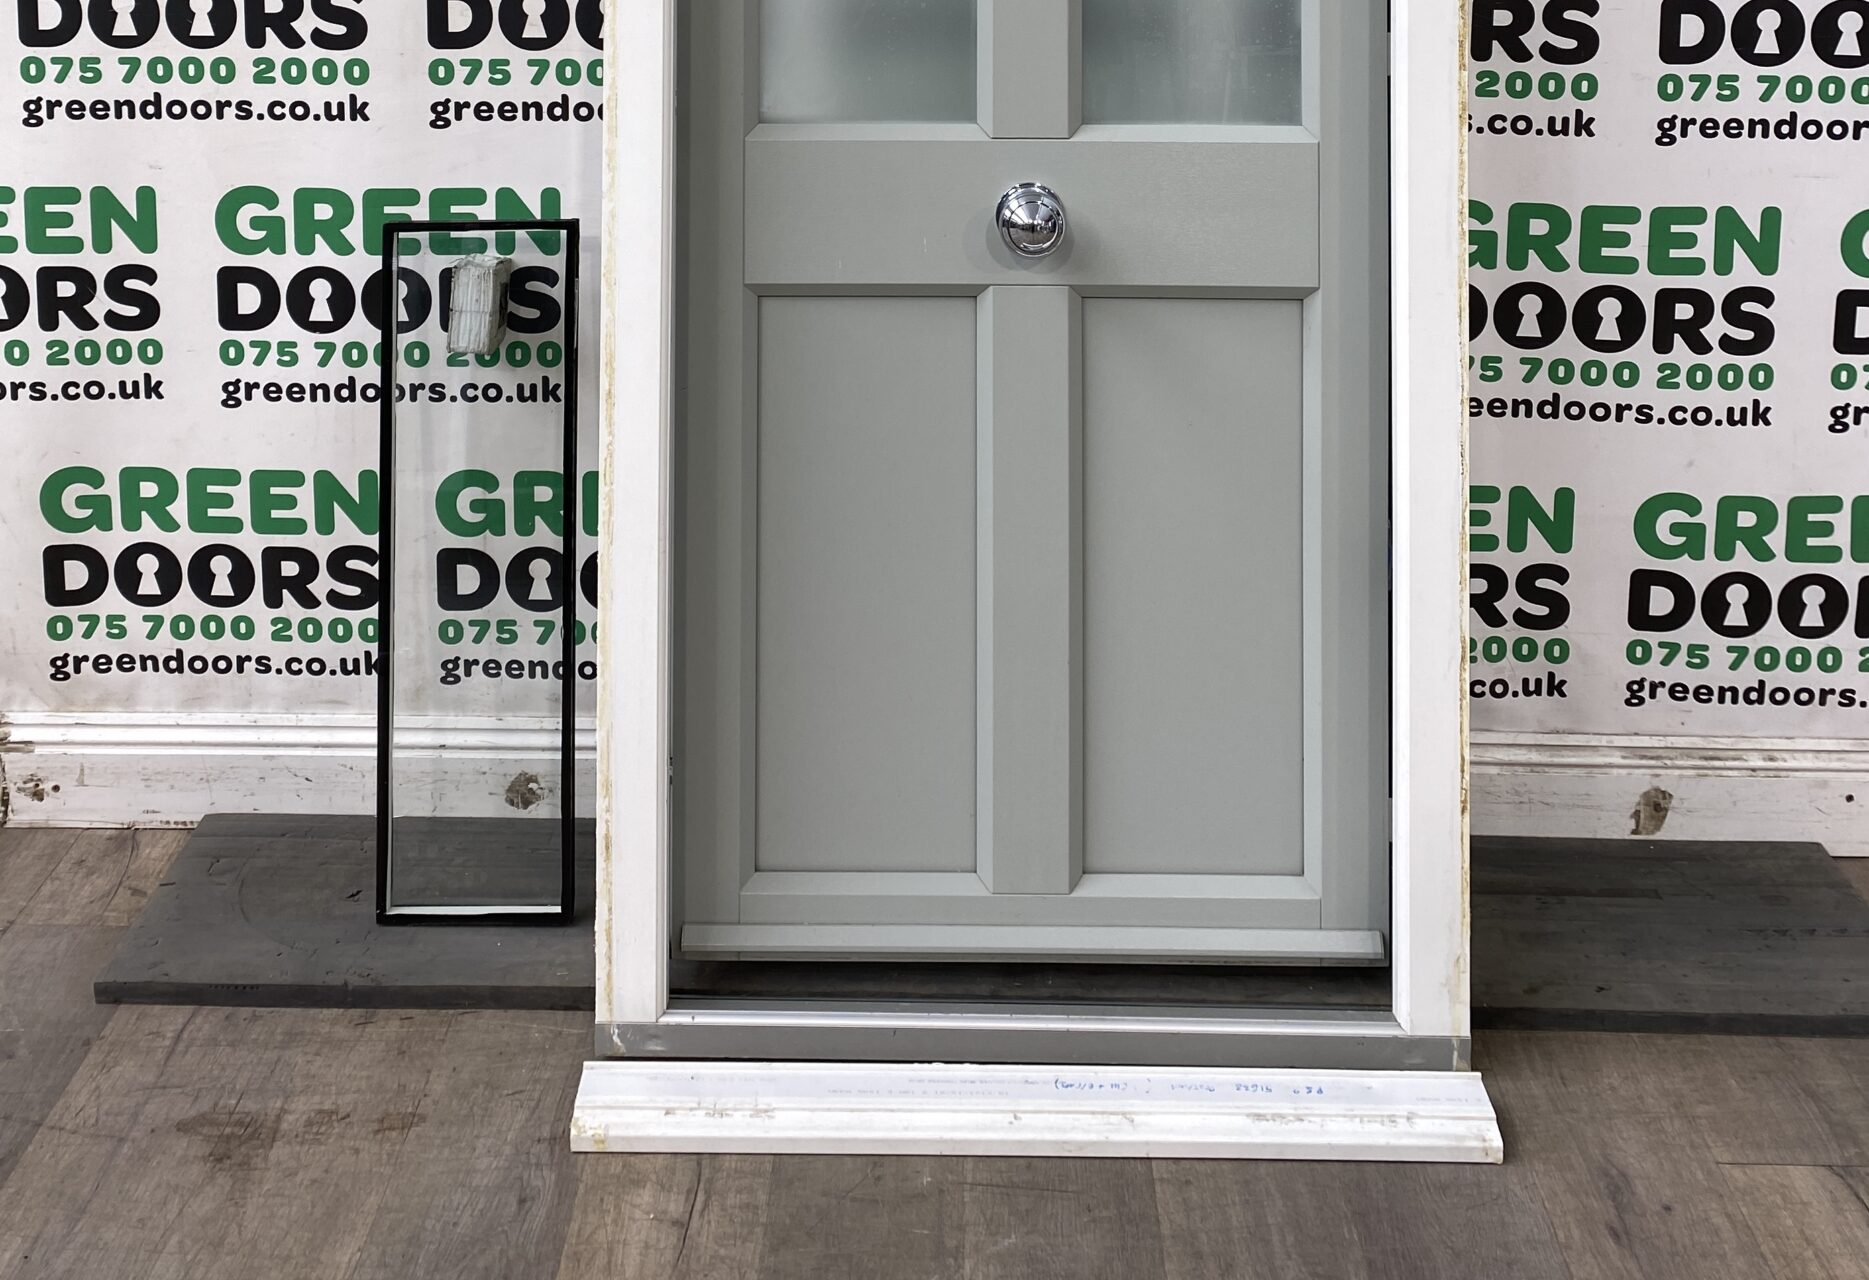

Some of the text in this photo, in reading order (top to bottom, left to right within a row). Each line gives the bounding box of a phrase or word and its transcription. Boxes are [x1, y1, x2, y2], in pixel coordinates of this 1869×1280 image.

[20, 56, 369, 86] 075 7000 2000
[428, 58, 510, 85] 075
[1477, 71, 1597, 100] 2000
[1659, 74, 1739, 101] 075
[23, 92, 369, 127] greendoors.co.uk
[1655, 111, 1869, 146] greendoor
[0, 186, 158, 254] EN
[215, 186, 560, 256] GREEN
[216, 264, 562, 334] DOOS
[1469, 281, 1775, 359] OORS
[47, 338, 163, 365] 2000
[220, 339, 298, 367] 075
[1521, 359, 1639, 387] 7000
[1658, 363, 1773, 390] 2000
[1469, 389, 1771, 426] eendoors.co.uk
[39, 466, 380, 535] GREEN
[435, 469, 598, 538] GR
[42, 541, 379, 610] DOORS
[436, 546, 598, 612] DO
[1628, 569, 1869, 642] DOO
[47, 614, 379, 643] 075 7000 2000
[439, 620, 517, 644] 075
[49, 648, 379, 682] greendoors.co.uk
[1471, 637, 1568, 663] 000
[1627, 640, 1707, 669] 075
[1728, 646, 1842, 672] 7000
